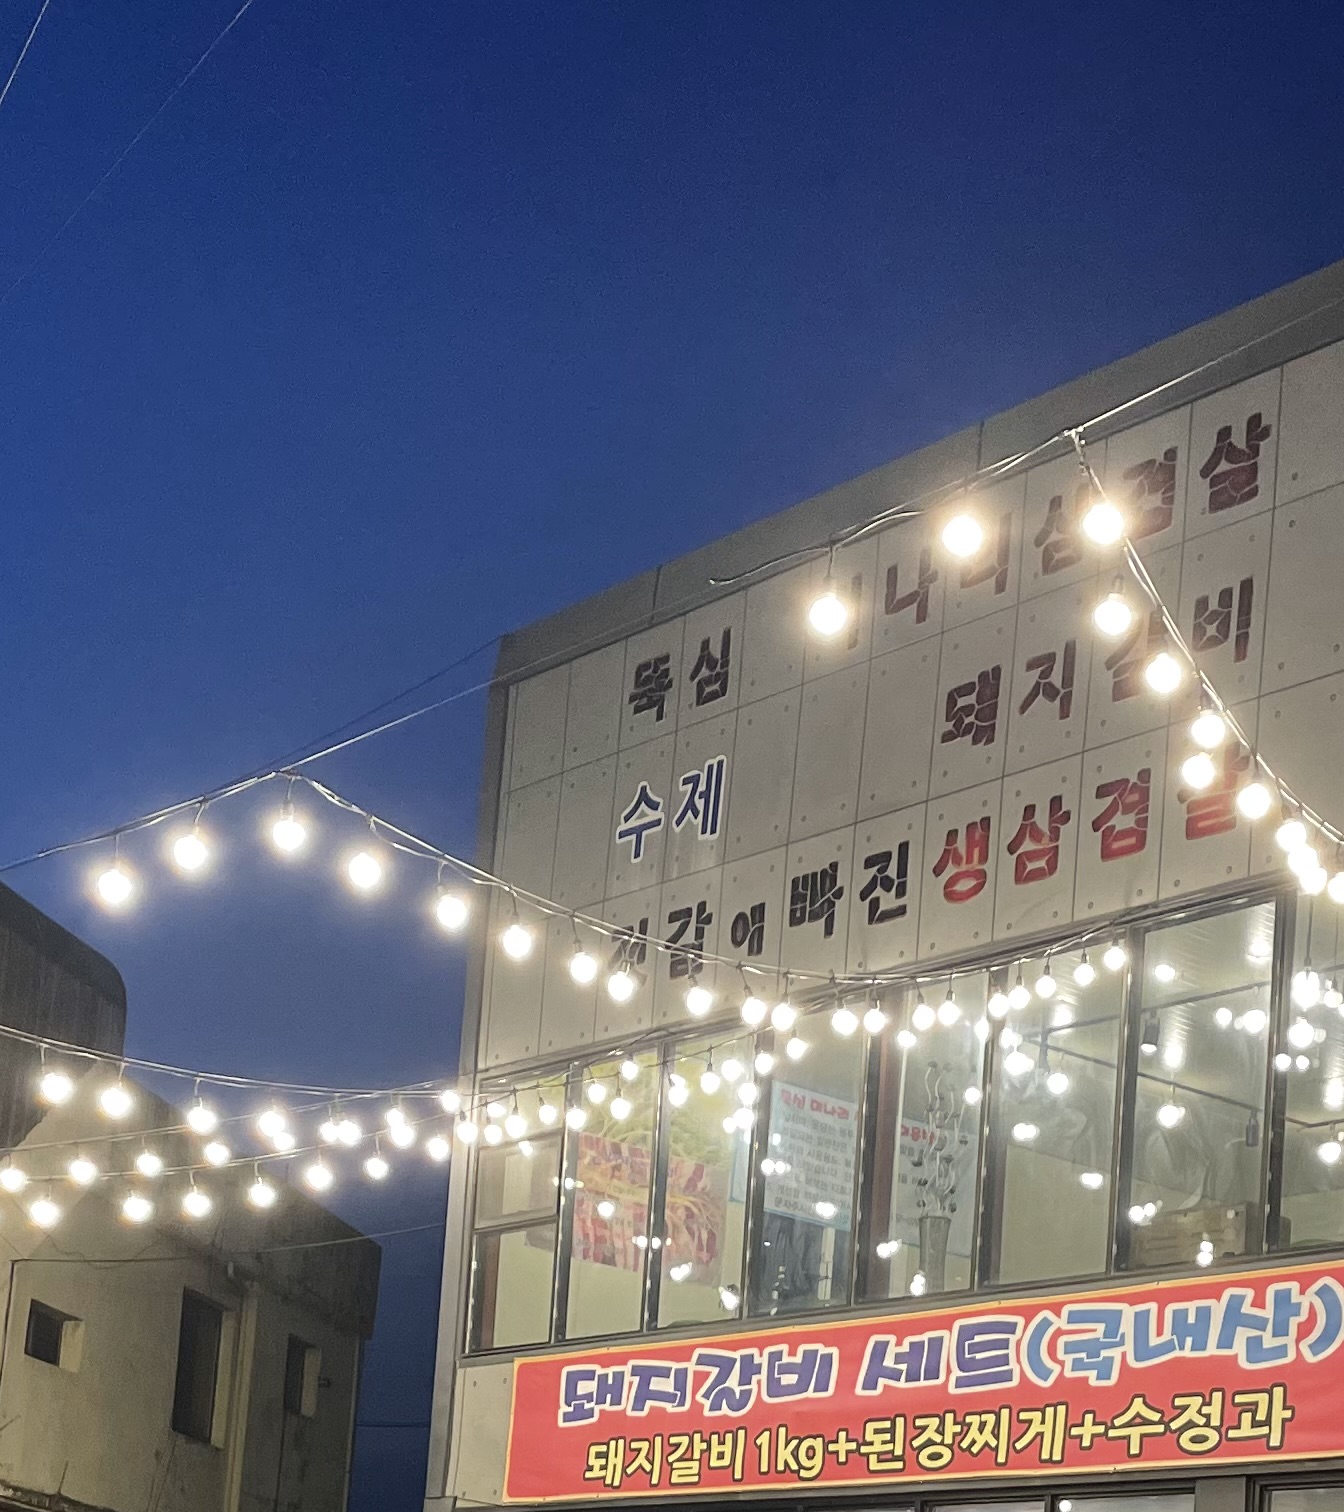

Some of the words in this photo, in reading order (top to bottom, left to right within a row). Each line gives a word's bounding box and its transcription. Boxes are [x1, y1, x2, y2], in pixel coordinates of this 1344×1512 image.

[628, 626, 732, 722] 뚝심
[814, 412, 1272, 650] 나리삼겹살
[616, 755, 727, 863] 수제
[558, 1342, 836, 1427] 돼지갈비
